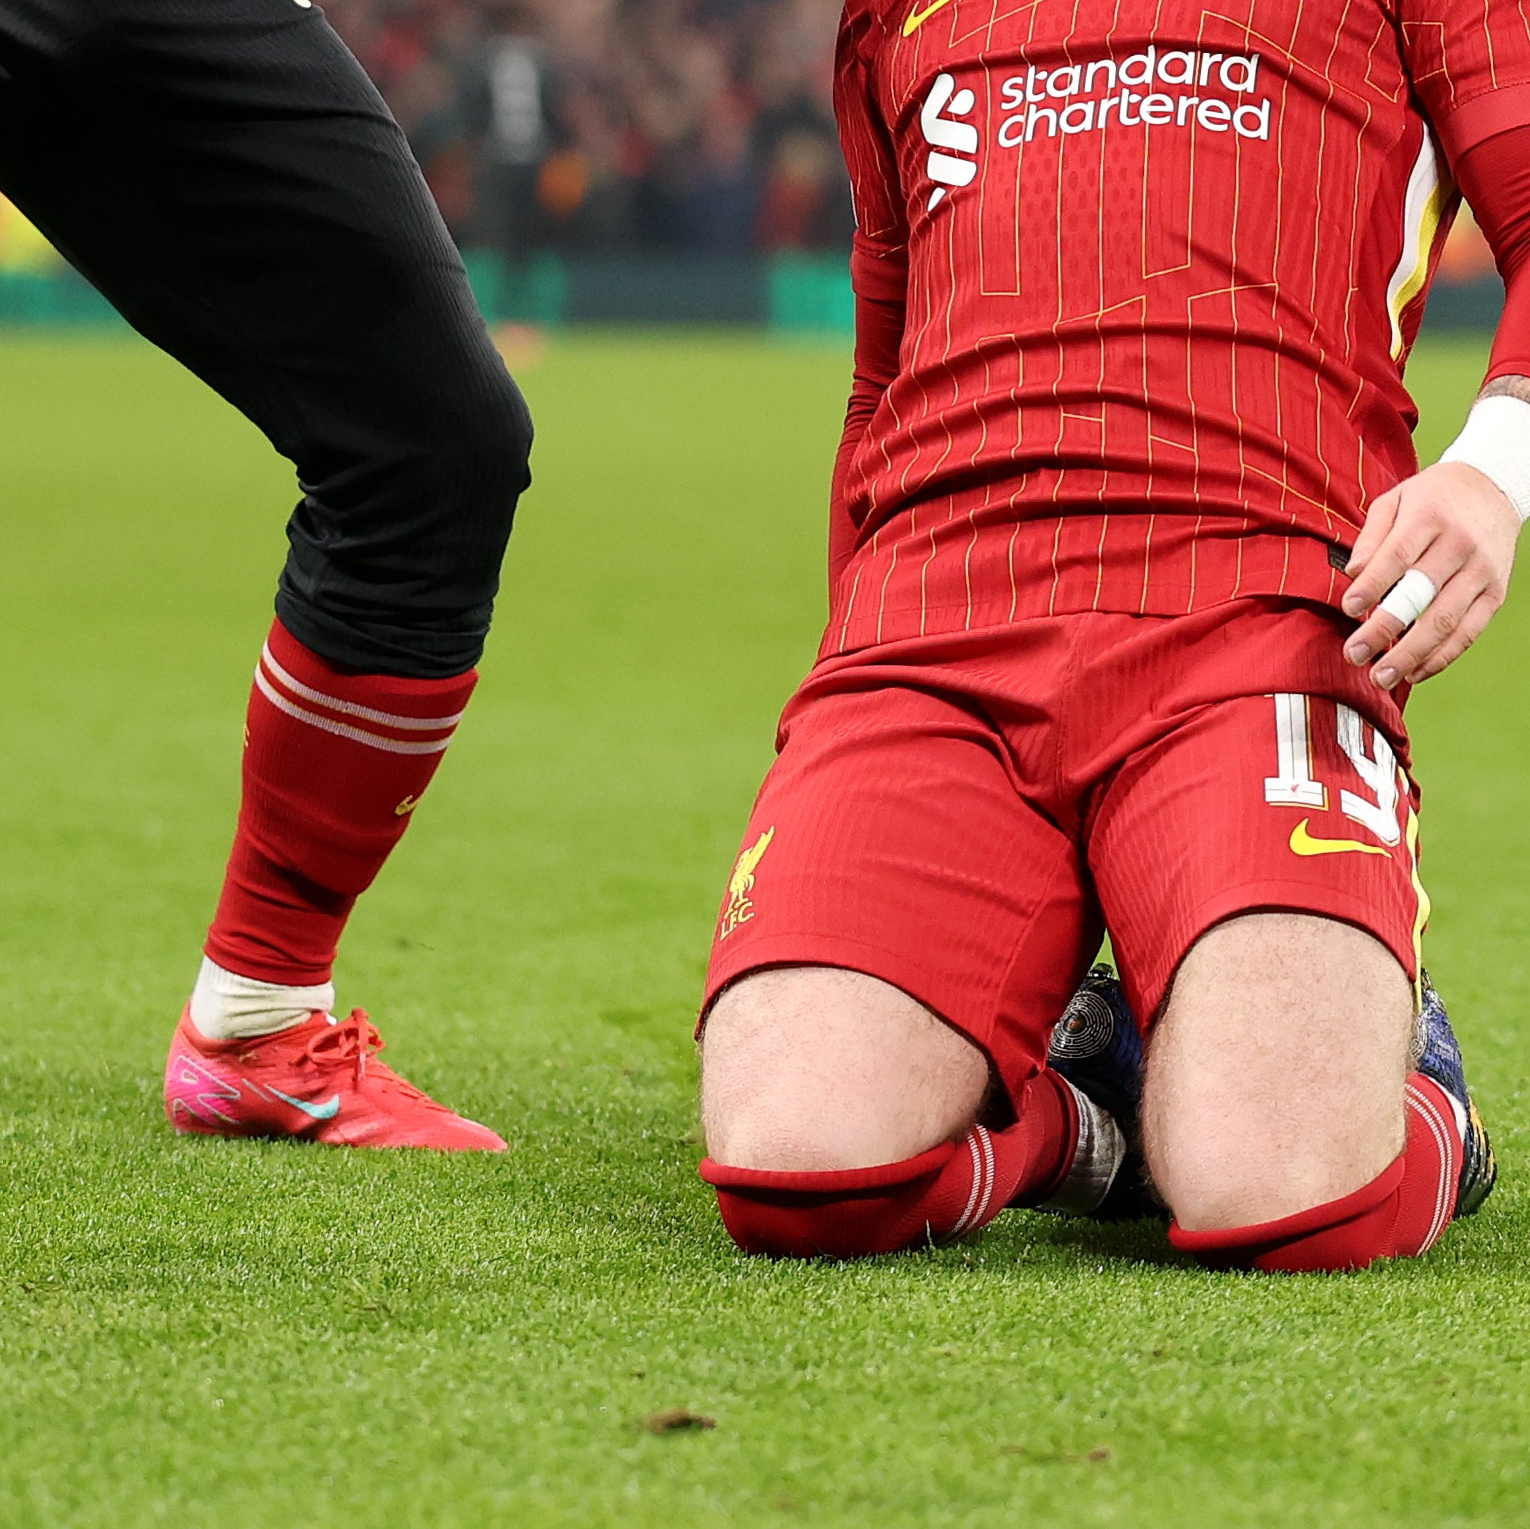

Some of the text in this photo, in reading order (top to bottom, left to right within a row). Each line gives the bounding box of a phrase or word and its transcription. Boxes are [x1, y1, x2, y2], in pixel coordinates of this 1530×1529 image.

[1000, 44, 1261, 111] standard
[997, 88, 1271, 148] chartered
[1263, 692, 1402, 847] 19
